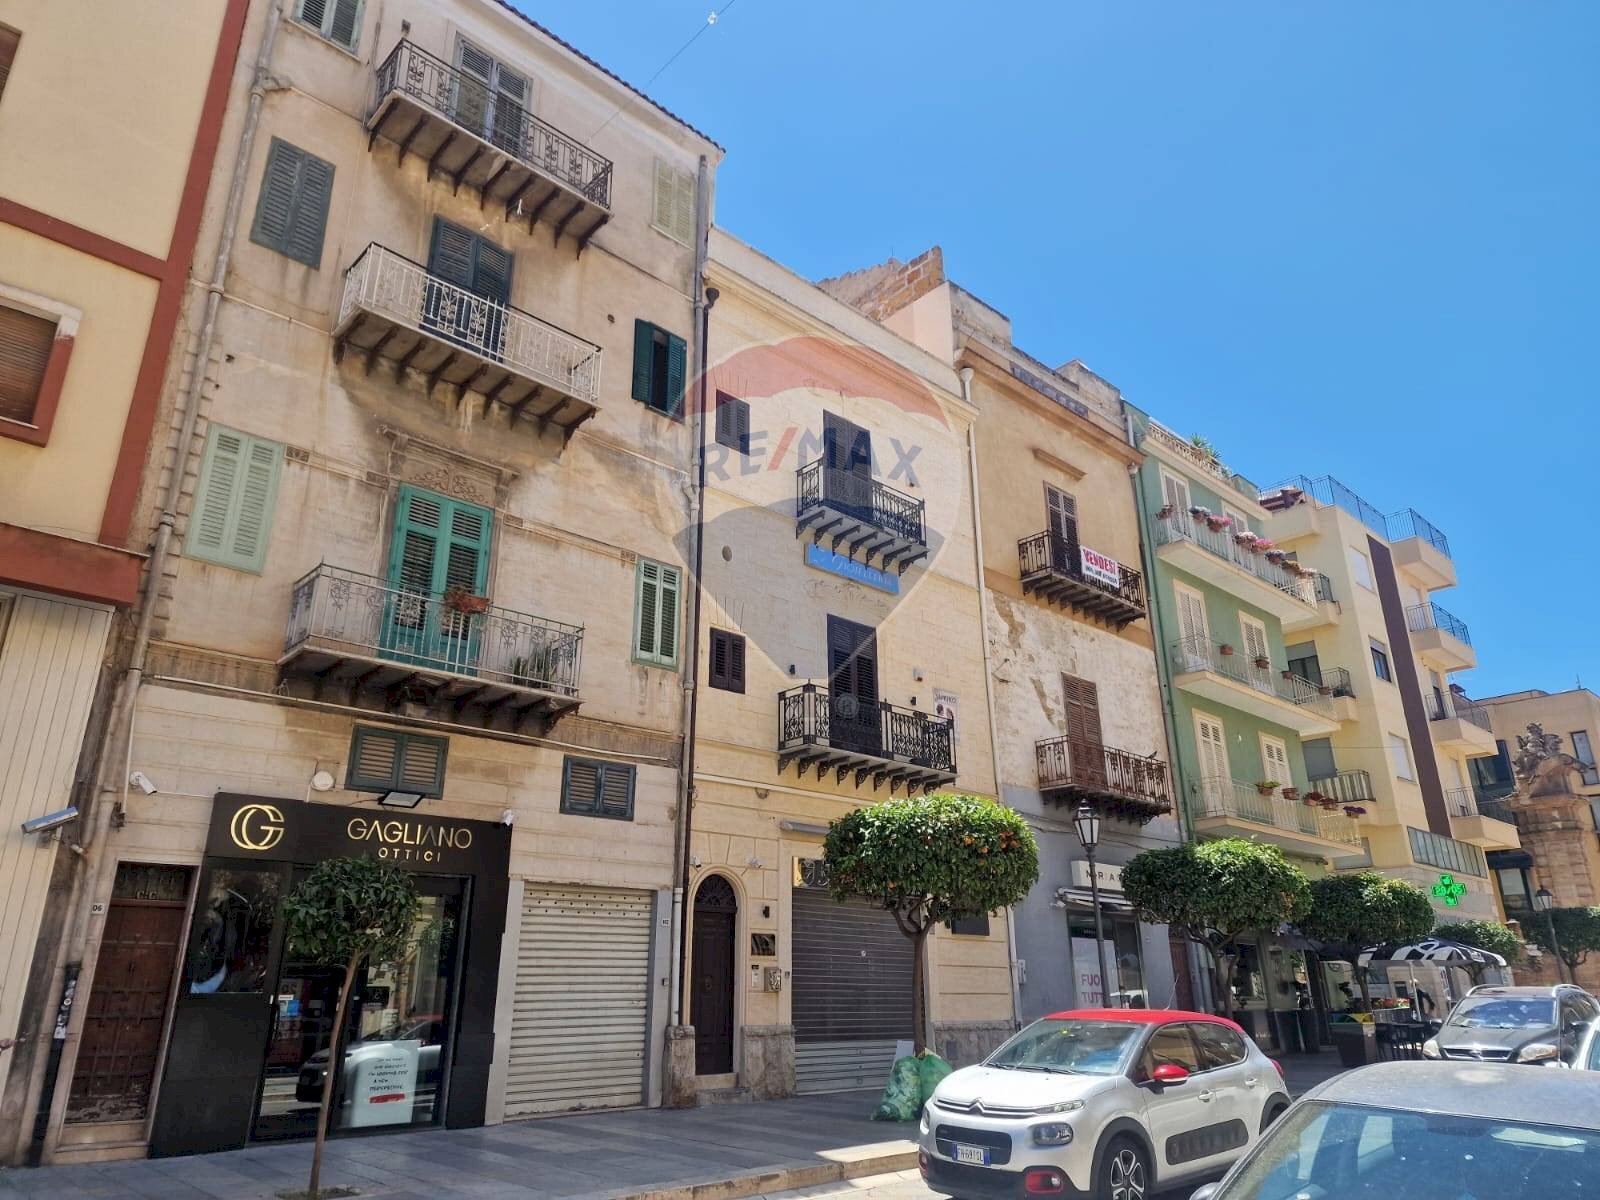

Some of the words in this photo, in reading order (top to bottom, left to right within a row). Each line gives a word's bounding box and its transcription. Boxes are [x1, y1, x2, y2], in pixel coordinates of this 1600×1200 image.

[1082, 549, 1117, 575] VENDESI
[346, 817, 473, 849] GAGLIANO
[378, 847, 441, 863] OTTICI
[1081, 973, 1103, 987] FUO
